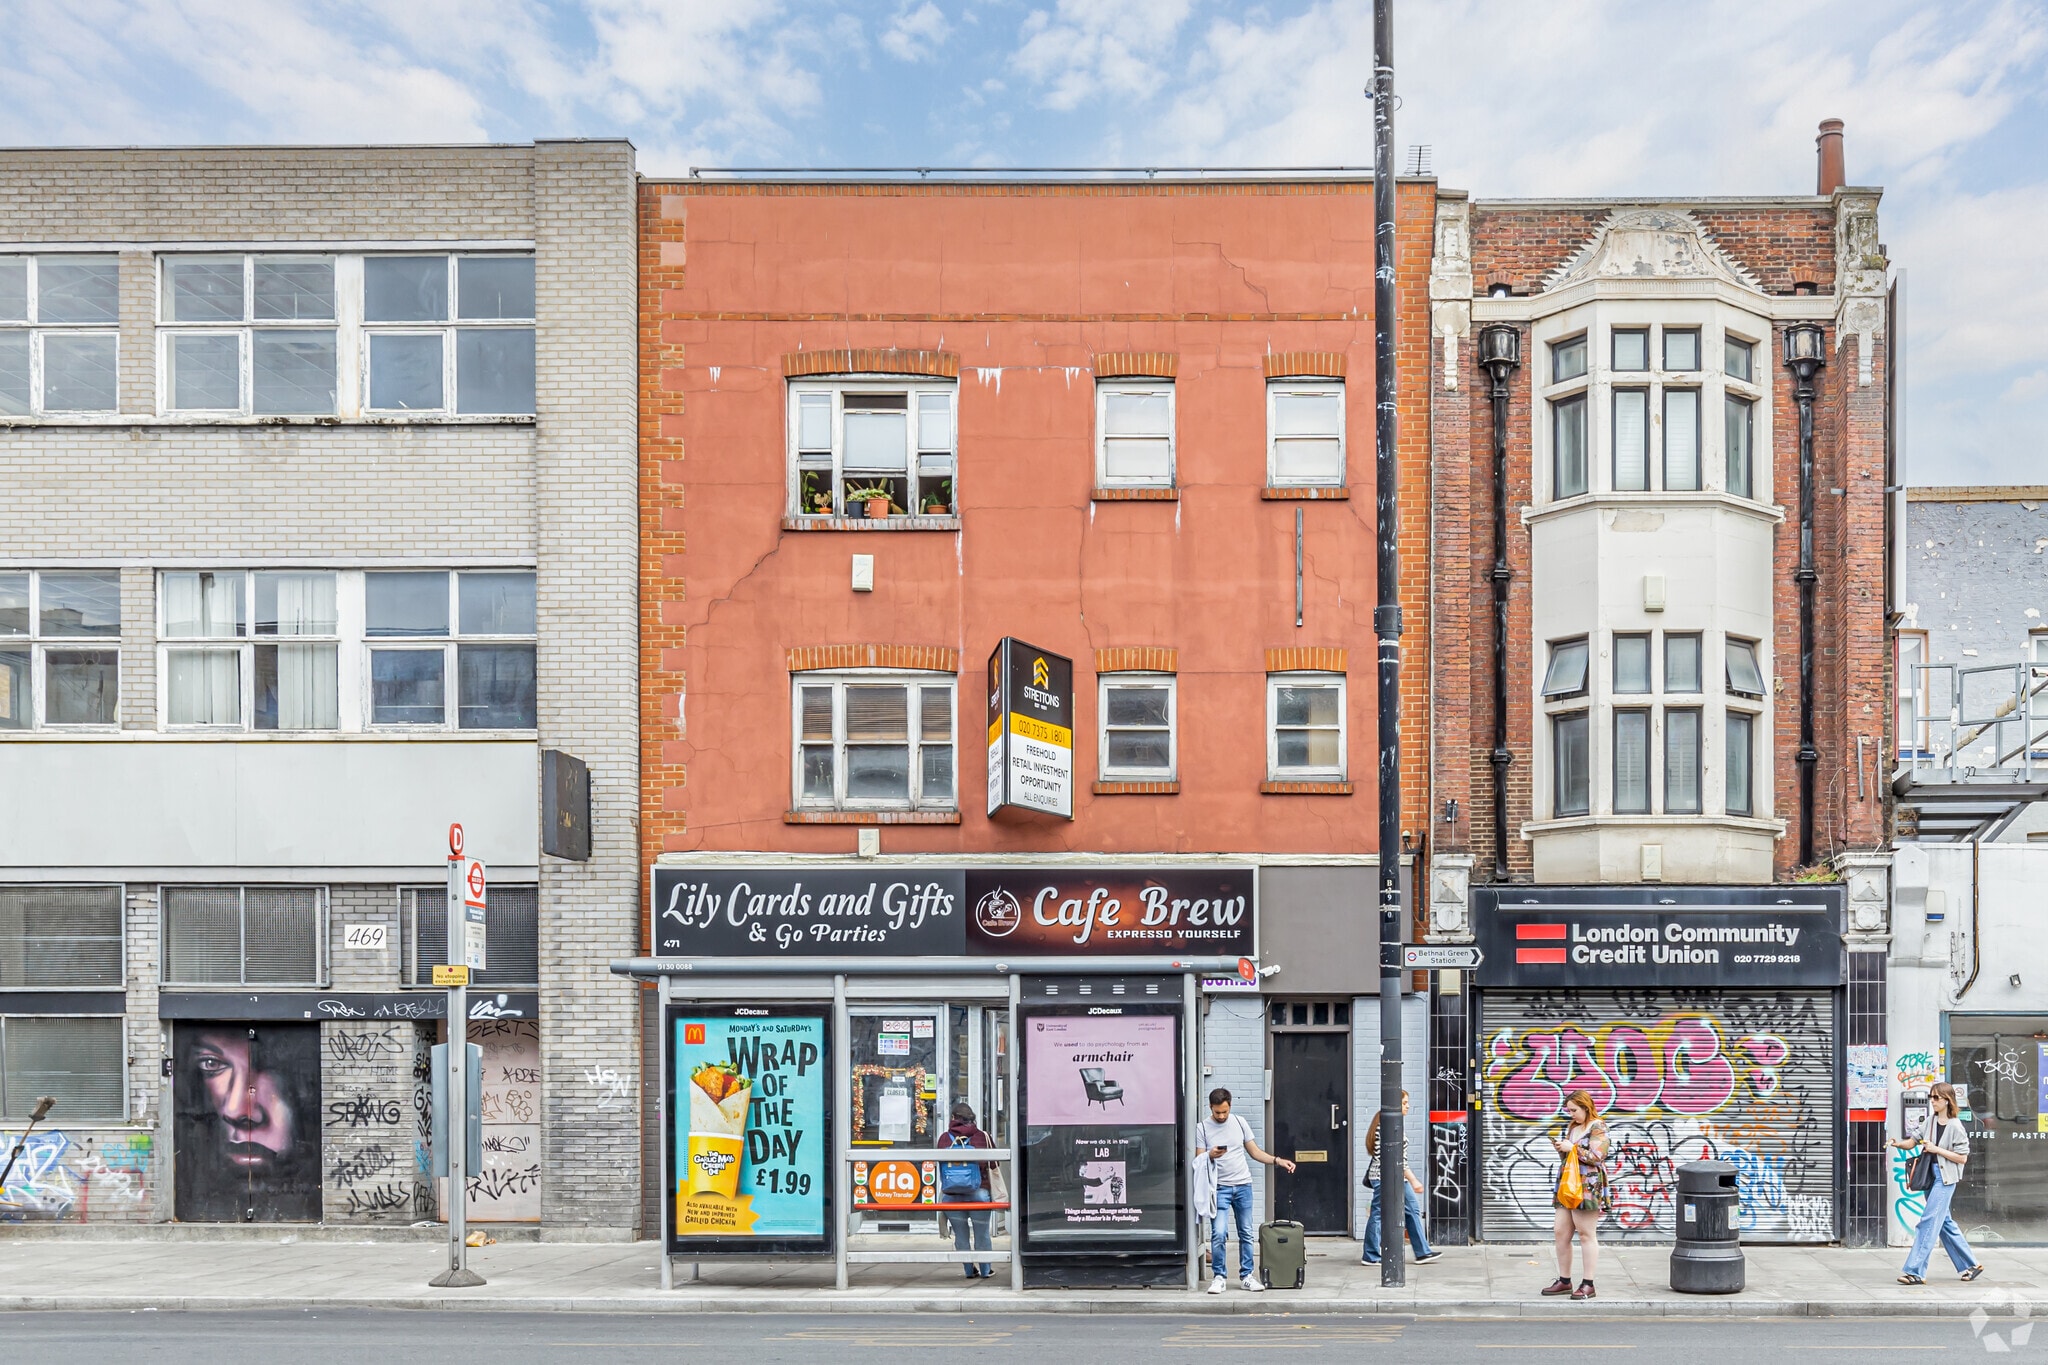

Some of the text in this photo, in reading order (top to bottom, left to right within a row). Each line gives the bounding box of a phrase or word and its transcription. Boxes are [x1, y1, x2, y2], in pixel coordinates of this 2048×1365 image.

[1024, 686, 1059, 707] STRETTONS
[1019, 720, 1064, 744] 020 7375 1801
[1026, 744, 1056, 761] FREEHOLD
[1012, 756, 1068, 779] RETAIL INVESTMENT
[1020, 775, 1061, 792] OPPORTUNITY
[1024, 792, 1058, 806] ALL ENQUIRIES
[453, 828, 462, 850] D
[662, 883, 954, 929] Lily Cards and Gifts
[1033, 886, 1245, 944] Cafe Brew
[348, 928, 384, 946] 469
[664, 940, 680, 948] 471
[749, 922, 886, 949] & Go Parties
[1107, 930, 1241, 939] EXPRESSO YOURSELF
[1572, 923, 1800, 946] London Community
[1572, 945, 1719, 964] Credit Union
[1734, 955, 1800, 963] 020 7729 9218
[727, 1036, 818, 1079] WRAP
[1072, 1051, 1134, 1062] armchair
[762, 1073, 788, 1097] OF
[749, 1097, 794, 1128] THE
[747, 1129, 803, 1166] DAY
[1094, 1147, 1110, 1158] LAB
[855, 1161, 866, 1169] ria
[923, 1161, 935, 1169] ria
[756, 1168, 811, 1196] £1.99
[875, 1164, 914, 1190] ria
[685, 1215, 736, 1226] GRILLED CHICKEN
